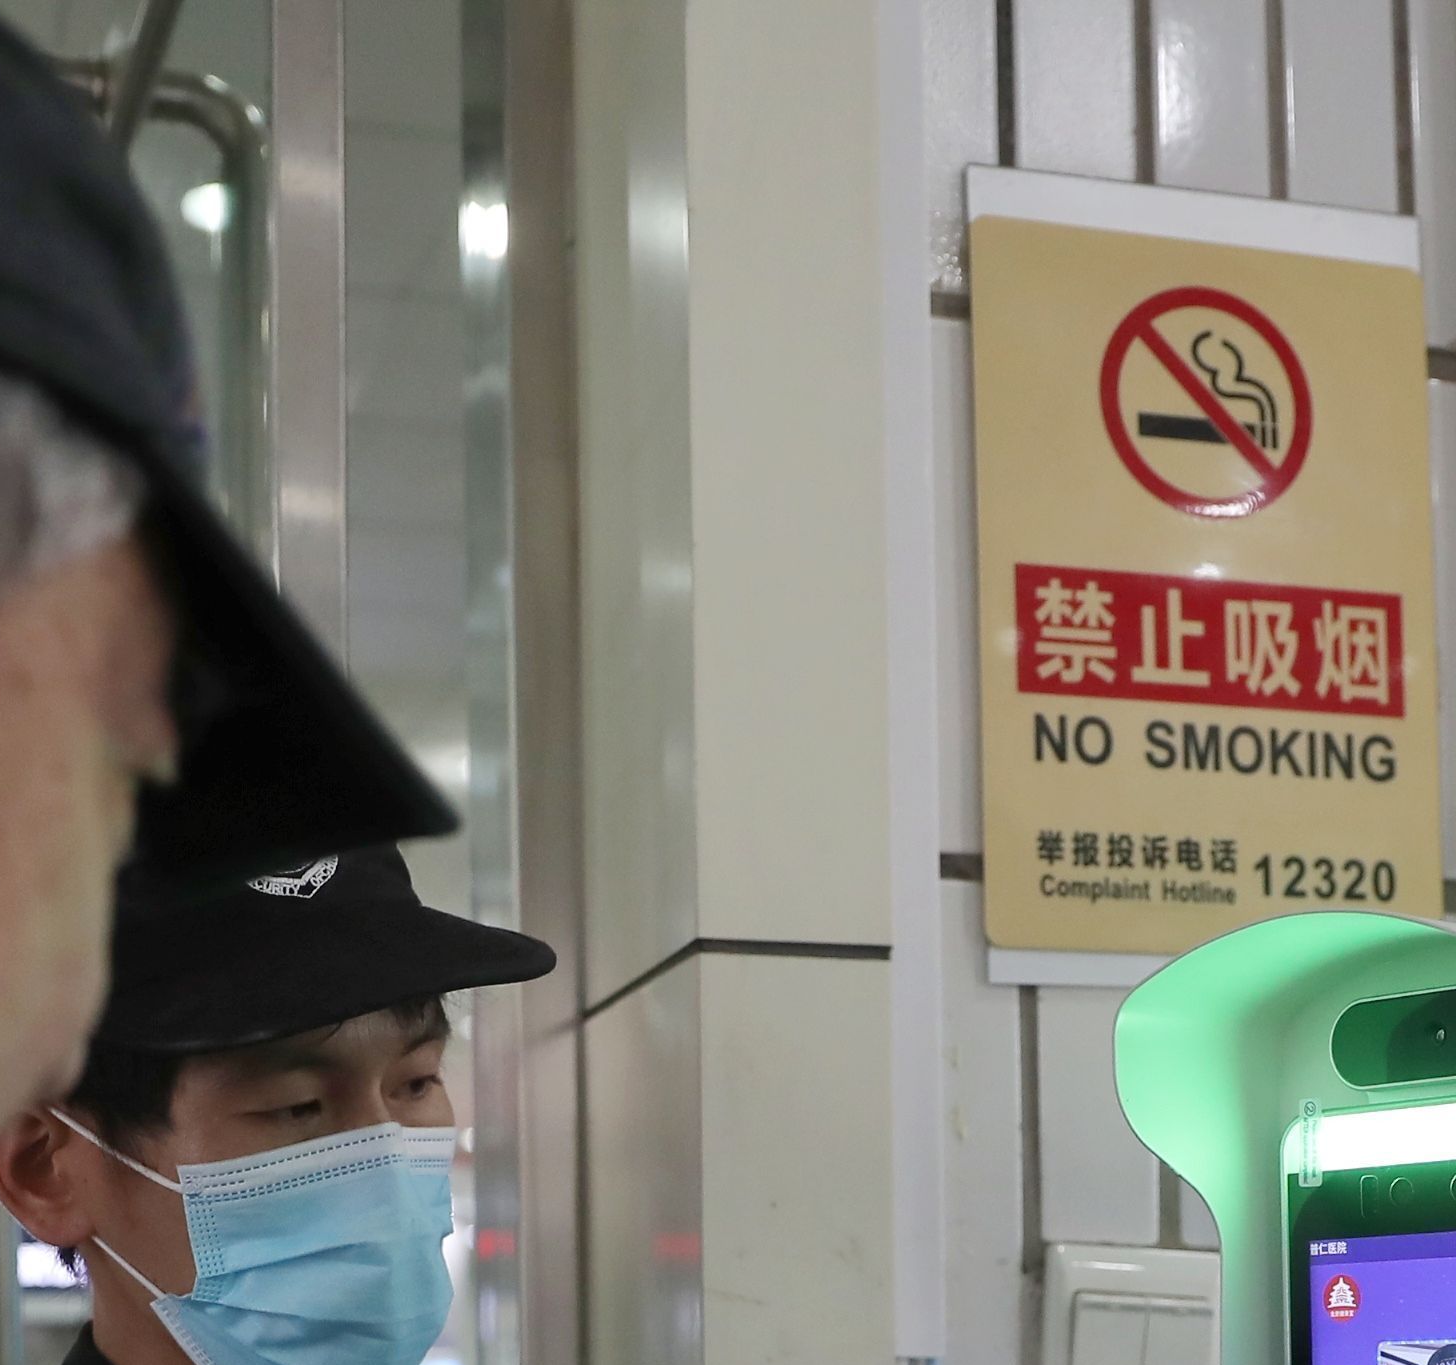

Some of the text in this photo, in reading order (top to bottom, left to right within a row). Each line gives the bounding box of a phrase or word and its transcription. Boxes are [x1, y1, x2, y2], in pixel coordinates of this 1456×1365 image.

[1033, 578, 1391, 706] 禁止吸烟
[1033, 713, 1398, 783] NO SMOKING
[1036, 829, 1239, 876] 举报投诉电话
[1040, 873, 1237, 907] Complaint Hotline
[1254, 855, 1398, 904] 12320
[1309, 1241, 1348, 1256] 普仁医院
